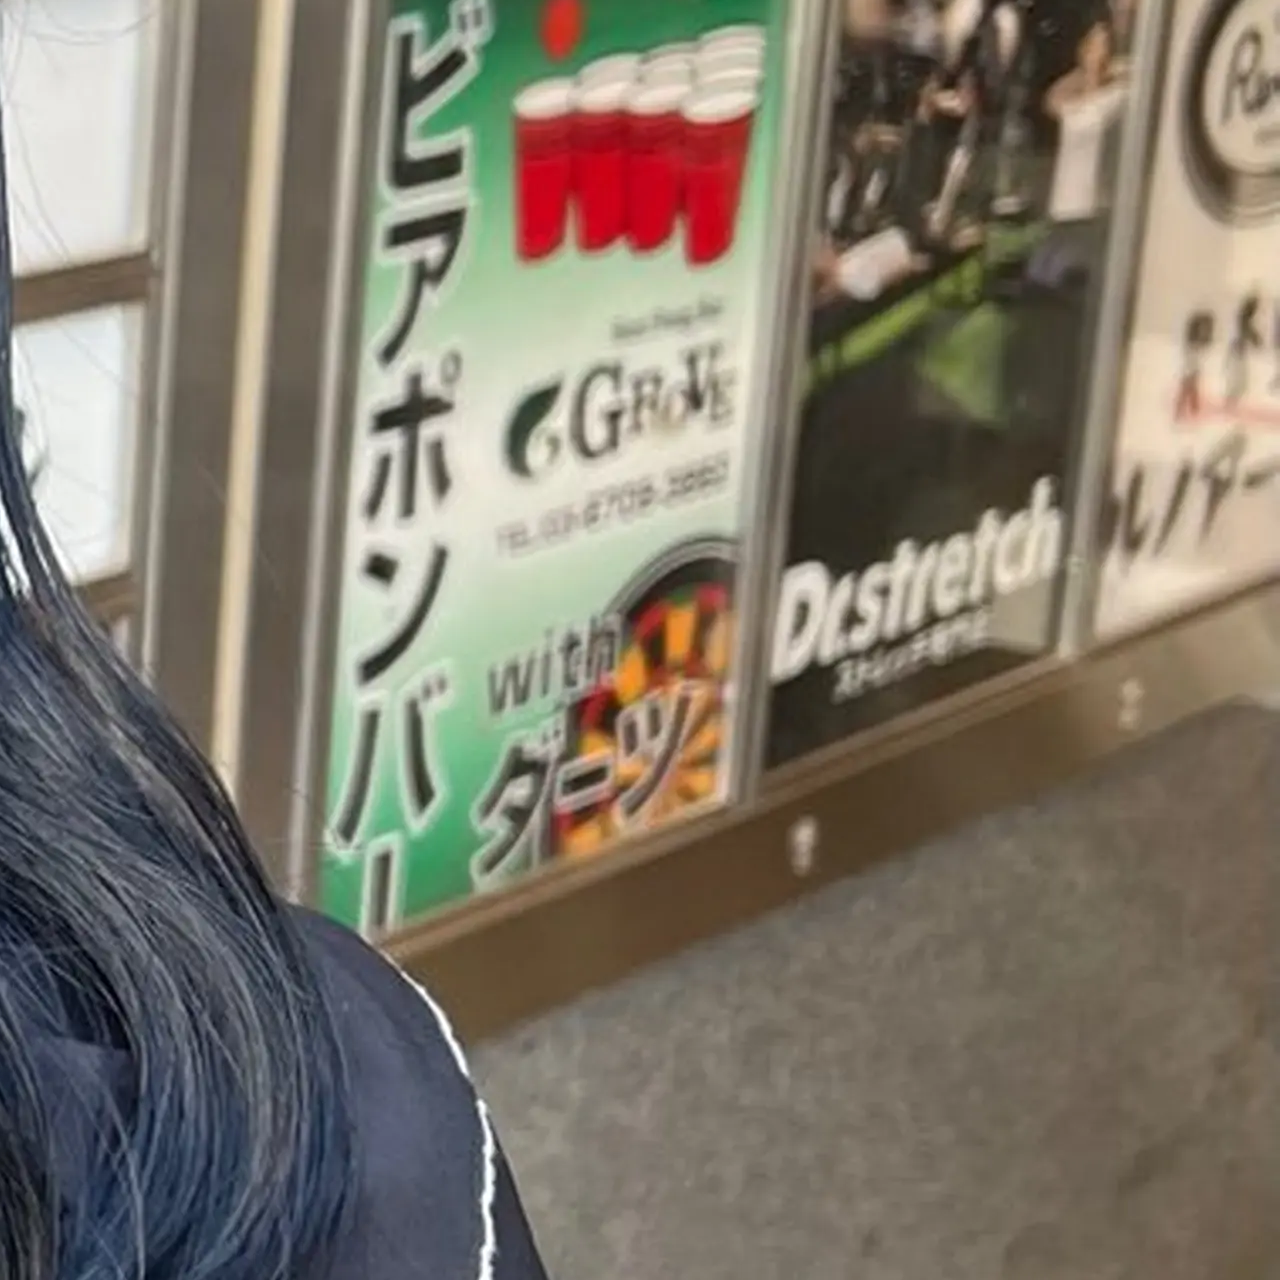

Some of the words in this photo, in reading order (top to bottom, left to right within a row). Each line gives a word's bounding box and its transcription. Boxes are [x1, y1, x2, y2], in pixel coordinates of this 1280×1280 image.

[487, 616, 622, 718] with
[472, 688, 695, 882] ダーツ
